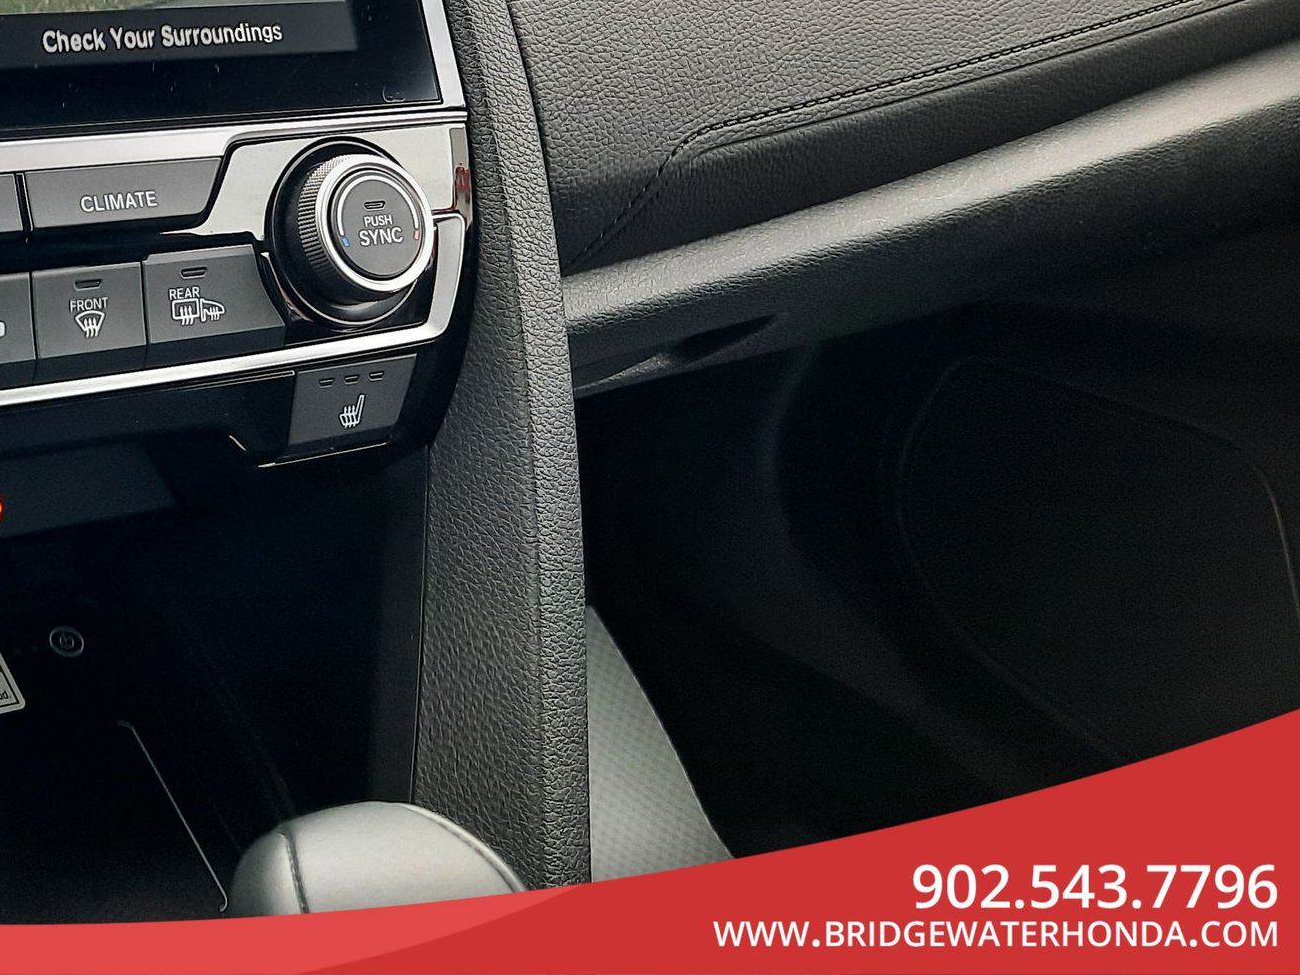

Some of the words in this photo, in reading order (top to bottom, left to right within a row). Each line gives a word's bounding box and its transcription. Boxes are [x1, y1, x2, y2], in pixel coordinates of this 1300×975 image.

[42, 28, 106, 53] Check
[109, 26, 155, 50] Your
[161, 22, 283, 48] Surroundings
[80, 190, 158, 212] CLIMATE
[363, 214, 393, 227] PUSH
[359, 226, 404, 246] SYNC
[169, 286, 200, 300] REAR
[70, 296, 108, 312] FRONT
